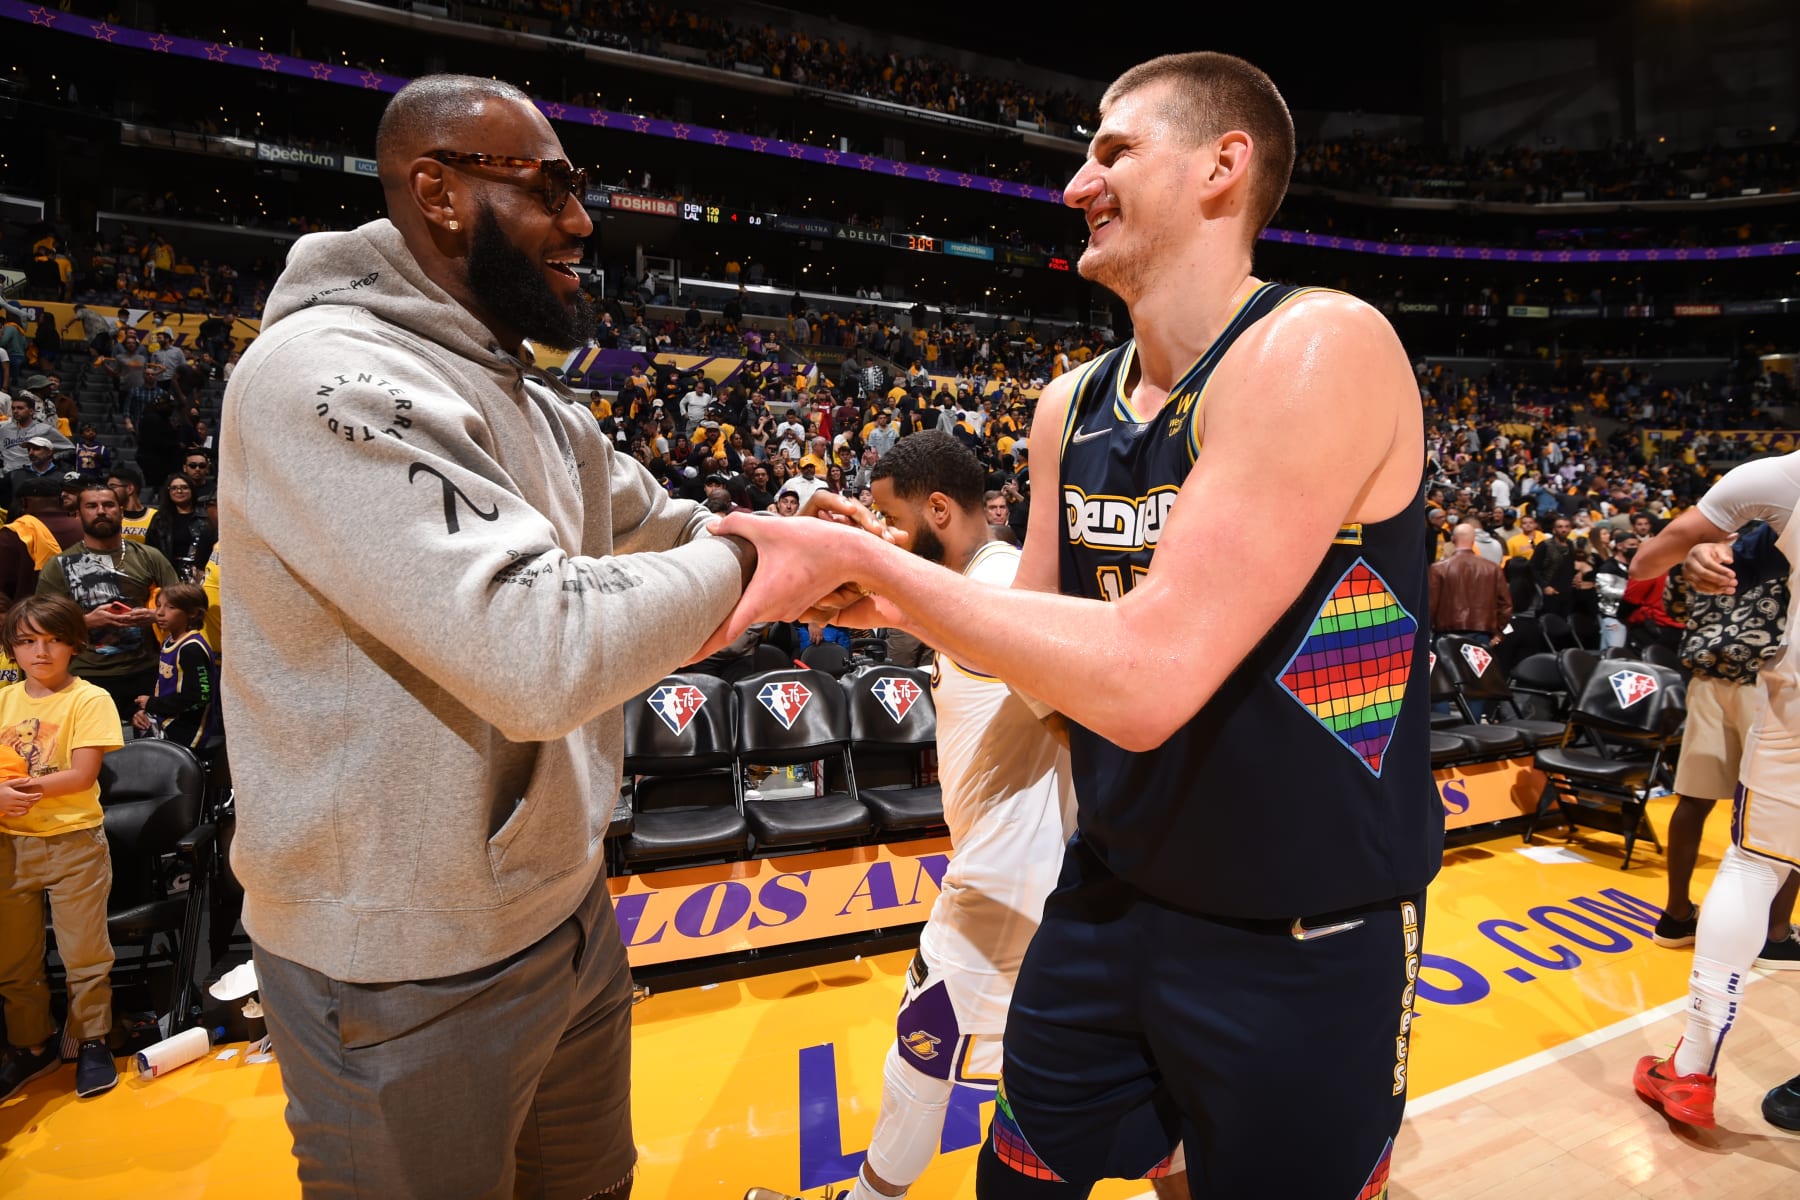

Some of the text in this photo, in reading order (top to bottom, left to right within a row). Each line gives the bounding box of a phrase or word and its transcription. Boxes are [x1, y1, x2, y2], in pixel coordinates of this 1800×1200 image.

[258, 143, 335, 167] Spectrum
[612, 196, 677, 215] TOSHIBA
[684, 204, 702, 213] DEN
[684, 212, 700, 221] LAL
[849, 229, 887, 243] DELTA
[788, 688, 800, 703] 75
[900, 684, 911, 698] 75
[683, 692, 694, 708] 75
[612, 871, 812, 947] LOS
